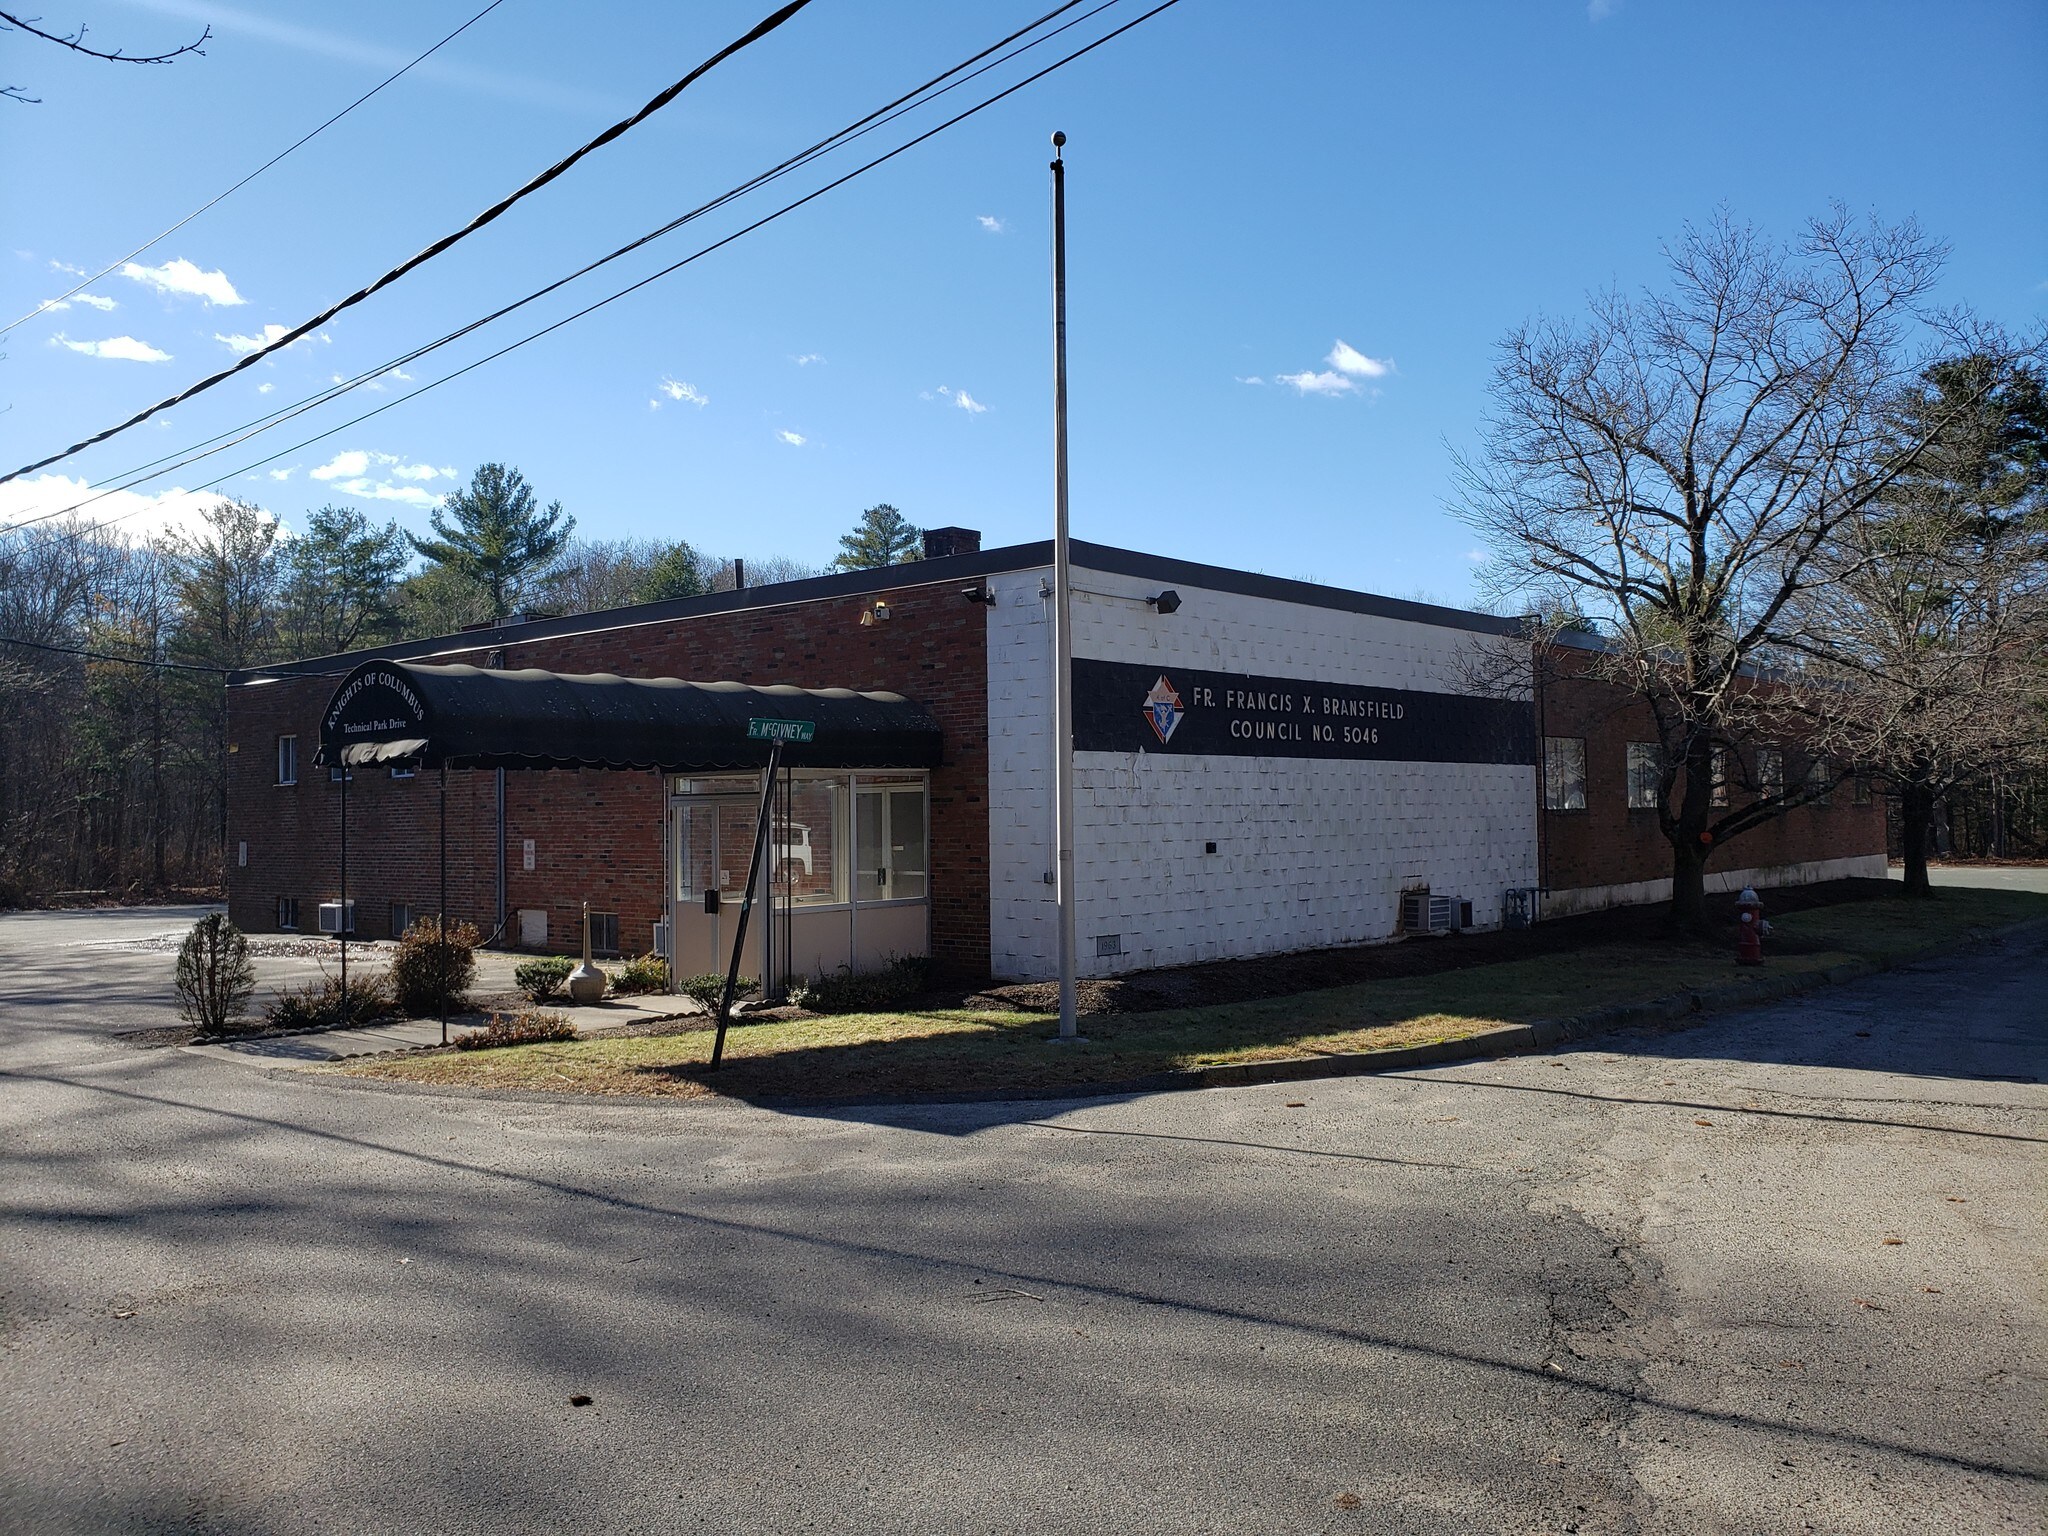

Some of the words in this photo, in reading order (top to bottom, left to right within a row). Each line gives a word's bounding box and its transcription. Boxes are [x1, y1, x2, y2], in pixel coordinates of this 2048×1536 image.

[328, 678, 362, 730] KNIGHTS
[364, 673, 376, 686] OF
[379, 673, 424, 721] COLUMBUS
[1193, 687, 1216, 707] FR.
[1227, 690, 1292, 712] FRANCIS
[1303, 696, 1315, 714] X.
[1323, 697, 1404, 719] BRANSFIELD
[344, 721, 372, 733] Technical
[374, 720, 388, 731] Park
[389, 718, 406, 729] Drive
[1231, 720, 1302, 740] COUNCIL
[1313, 724, 1335, 742] NO.
[1344, 726, 1378, 744] 5046
[1101, 940, 1117, 950] 1963
